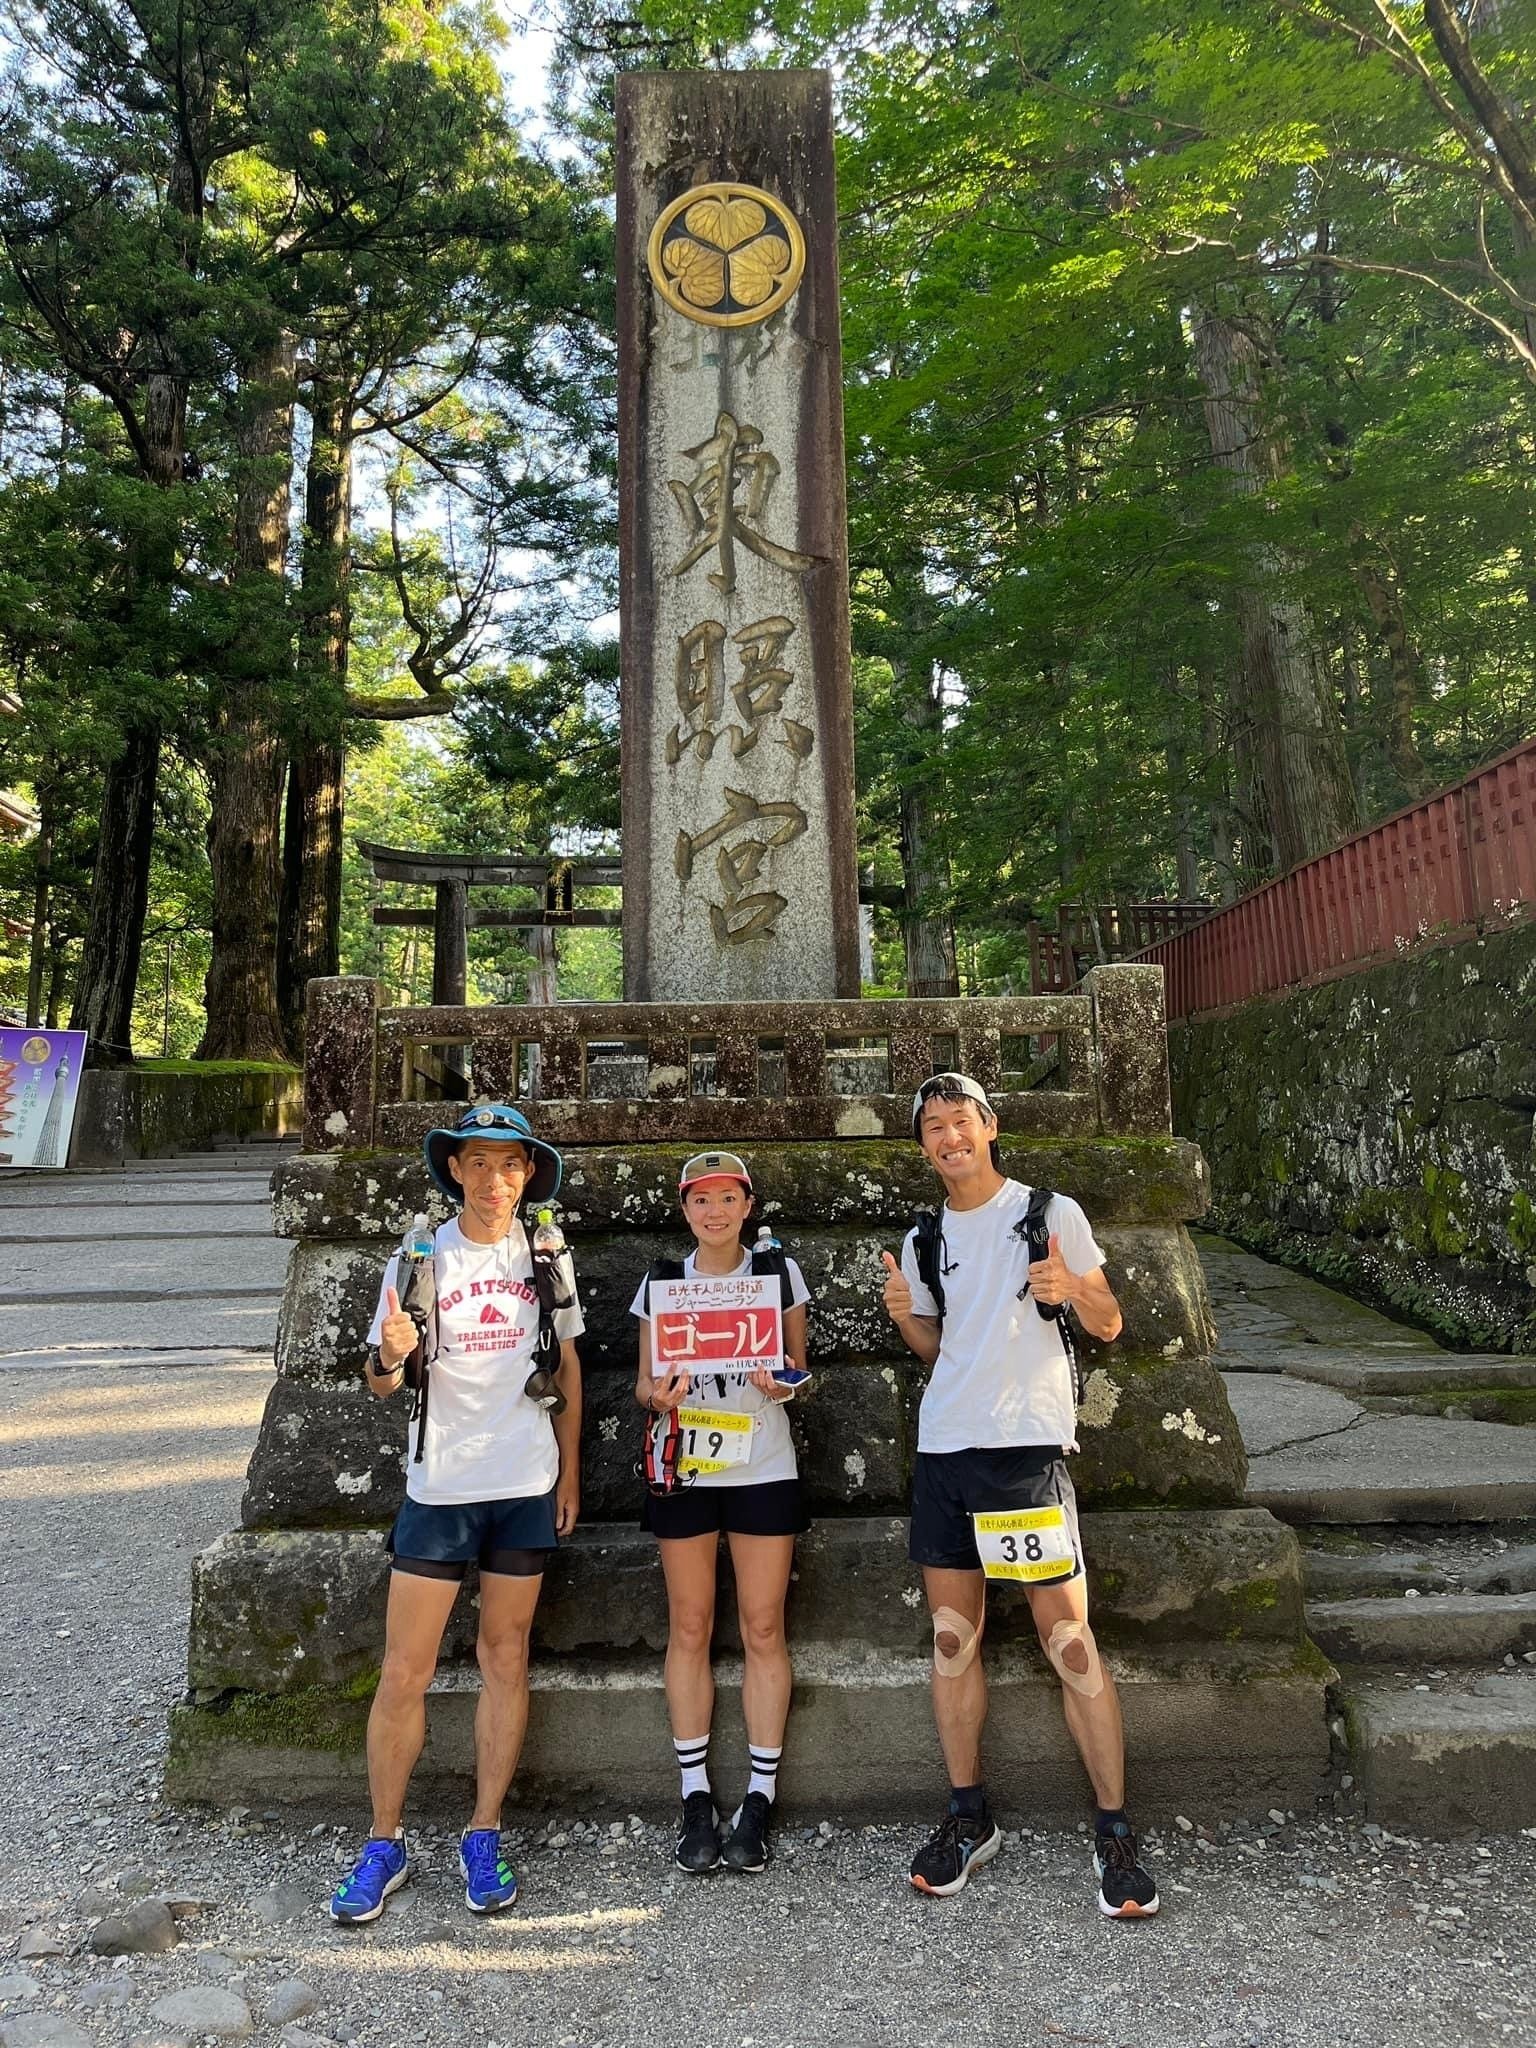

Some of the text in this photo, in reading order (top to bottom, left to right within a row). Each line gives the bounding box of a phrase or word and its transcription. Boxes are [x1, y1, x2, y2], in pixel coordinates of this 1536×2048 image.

[666, 410, 833, 947] 東照宮
[668, 1280, 764, 1297] 日光千人同心街道
[439, 1289, 464, 1312] GO
[674, 1295, 758, 1310] ジャーニーラン
[456, 1327, 526, 1343] TRACK&FIELD
[465, 1340, 517, 1353] ATHLETICS
[663, 1313, 773, 1357] ゴール
[688, 1428, 723, 1457] 19
[1000, 1533, 1043, 1563] 38
